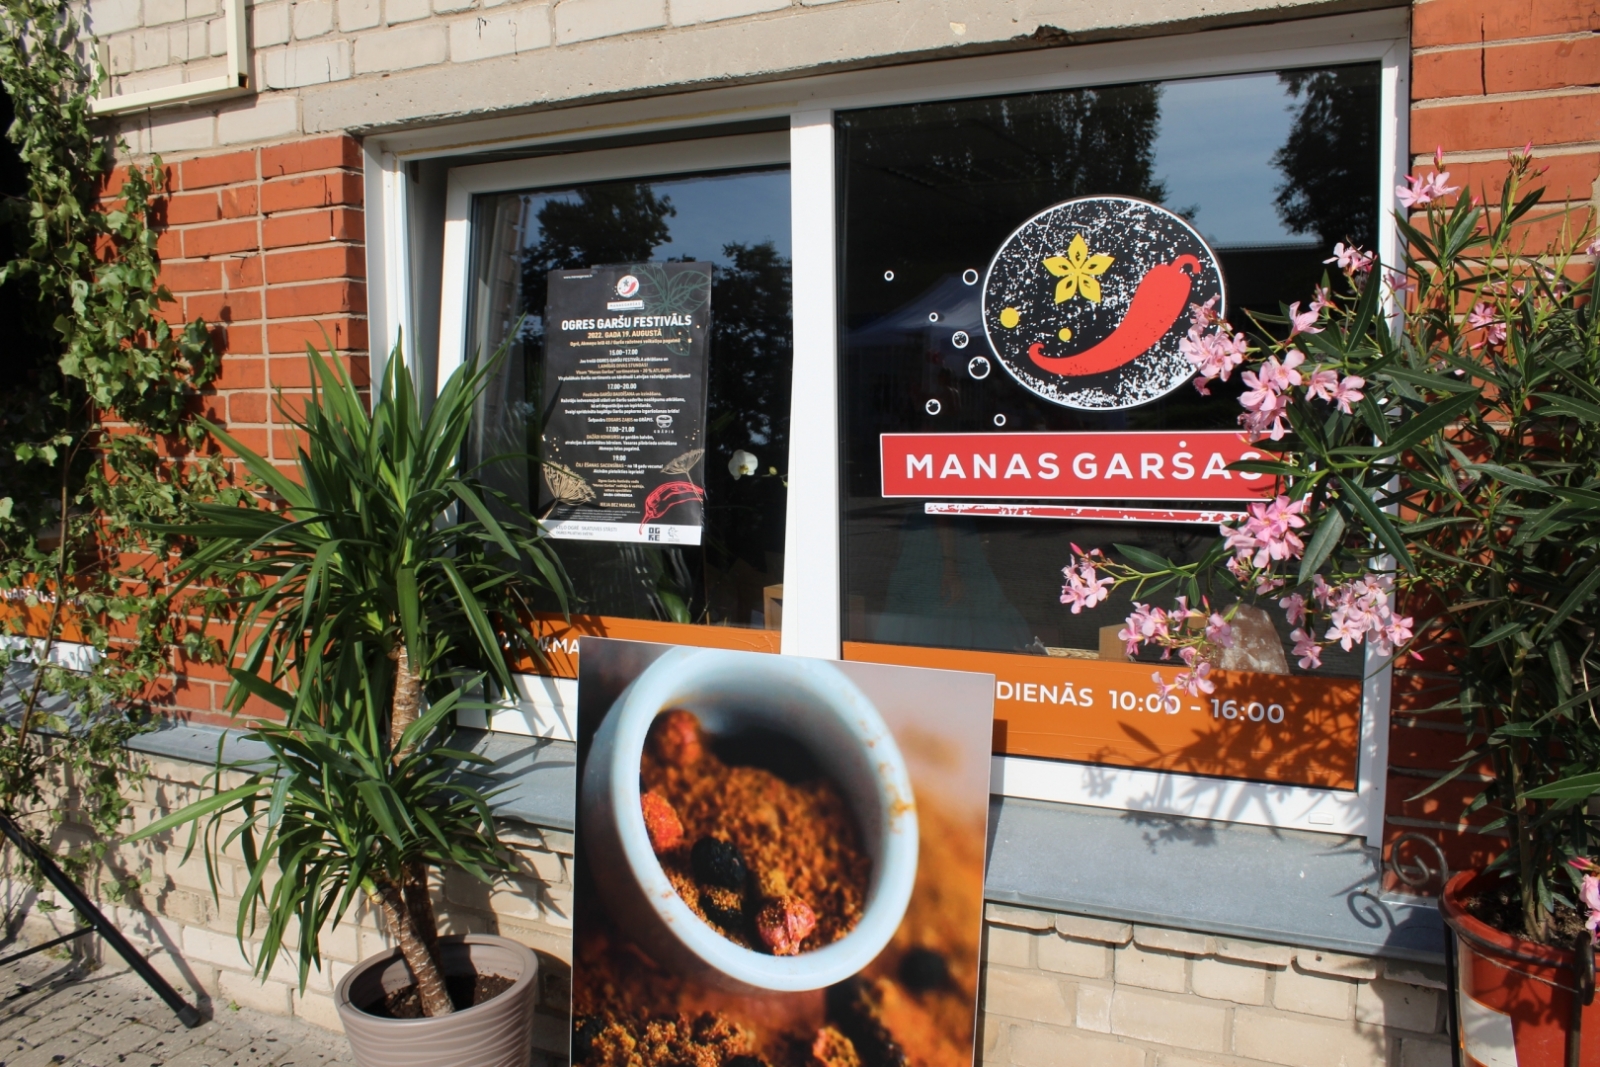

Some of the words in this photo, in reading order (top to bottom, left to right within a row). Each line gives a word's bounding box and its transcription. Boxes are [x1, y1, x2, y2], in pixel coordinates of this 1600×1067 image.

[562, 319, 595, 331] OGRES
[597, 315, 631, 329] GARŠU
[633, 313, 692, 327] FESTIVĀLS
[632, 329, 662, 337] AUGUSTĀ
[996, 681, 1094, 707] DIENĀS
[1108, 689, 1181, 715] 10:00
[1211, 698, 1285, 724] 16:00
